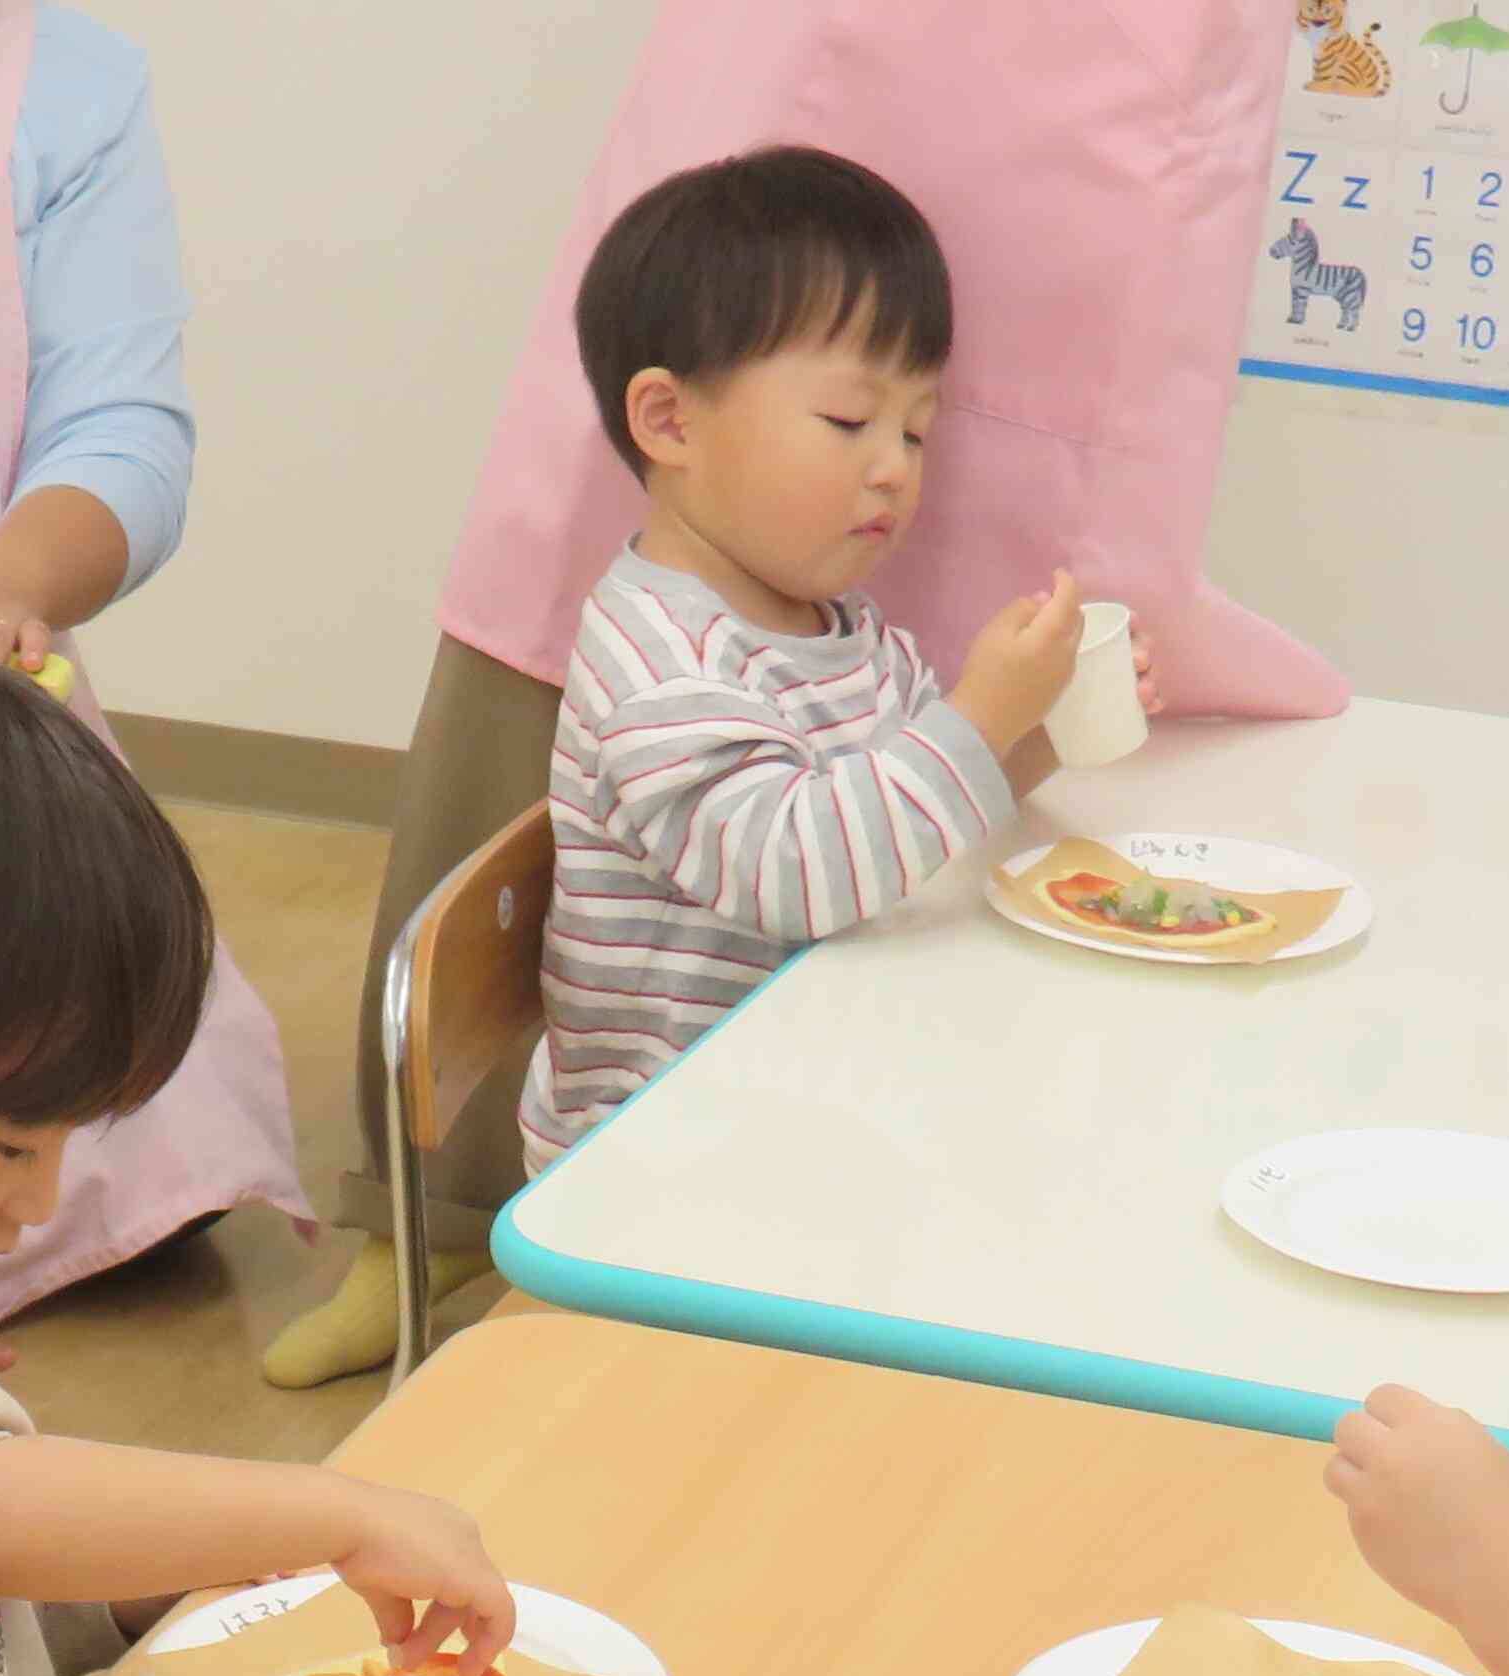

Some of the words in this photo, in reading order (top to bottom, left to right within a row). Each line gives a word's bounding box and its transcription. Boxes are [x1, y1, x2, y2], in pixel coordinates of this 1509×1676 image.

[1279, 151, 1317, 204] Z
[1341, 176, 1370, 209] z
[1422, 166, 1435, 201] 1
[1478, 172, 1503, 208] 2
[1410, 236, 1433, 271] 5
[1469, 243, 1494, 278] 6
[1402, 308, 1426, 342] 9
[1457, 314, 1496, 350] 10
